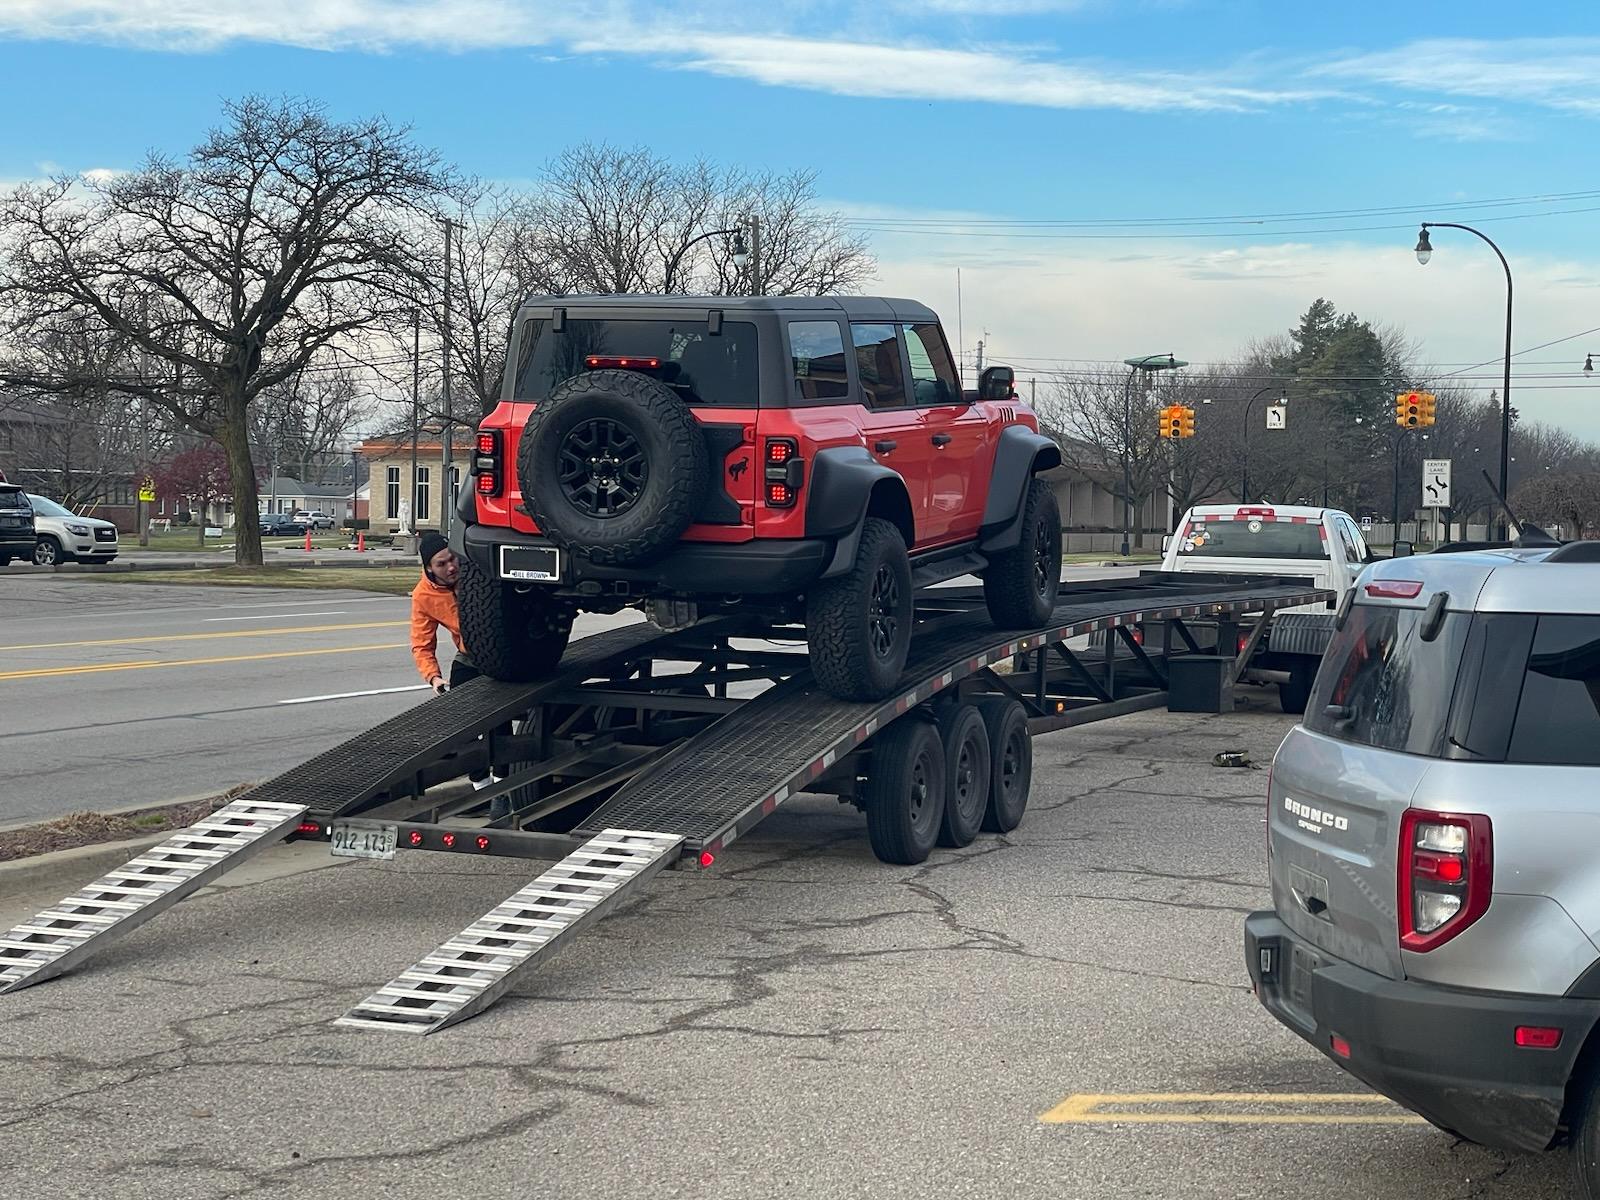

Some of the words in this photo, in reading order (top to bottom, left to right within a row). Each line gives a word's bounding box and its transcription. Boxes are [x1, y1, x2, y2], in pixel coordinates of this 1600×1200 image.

[526, 571, 546, 579] BROWN
[1284, 797, 1348, 831] BRONCO
[1298, 819, 1322, 834] SPORT
[335, 831, 358, 850] 912
